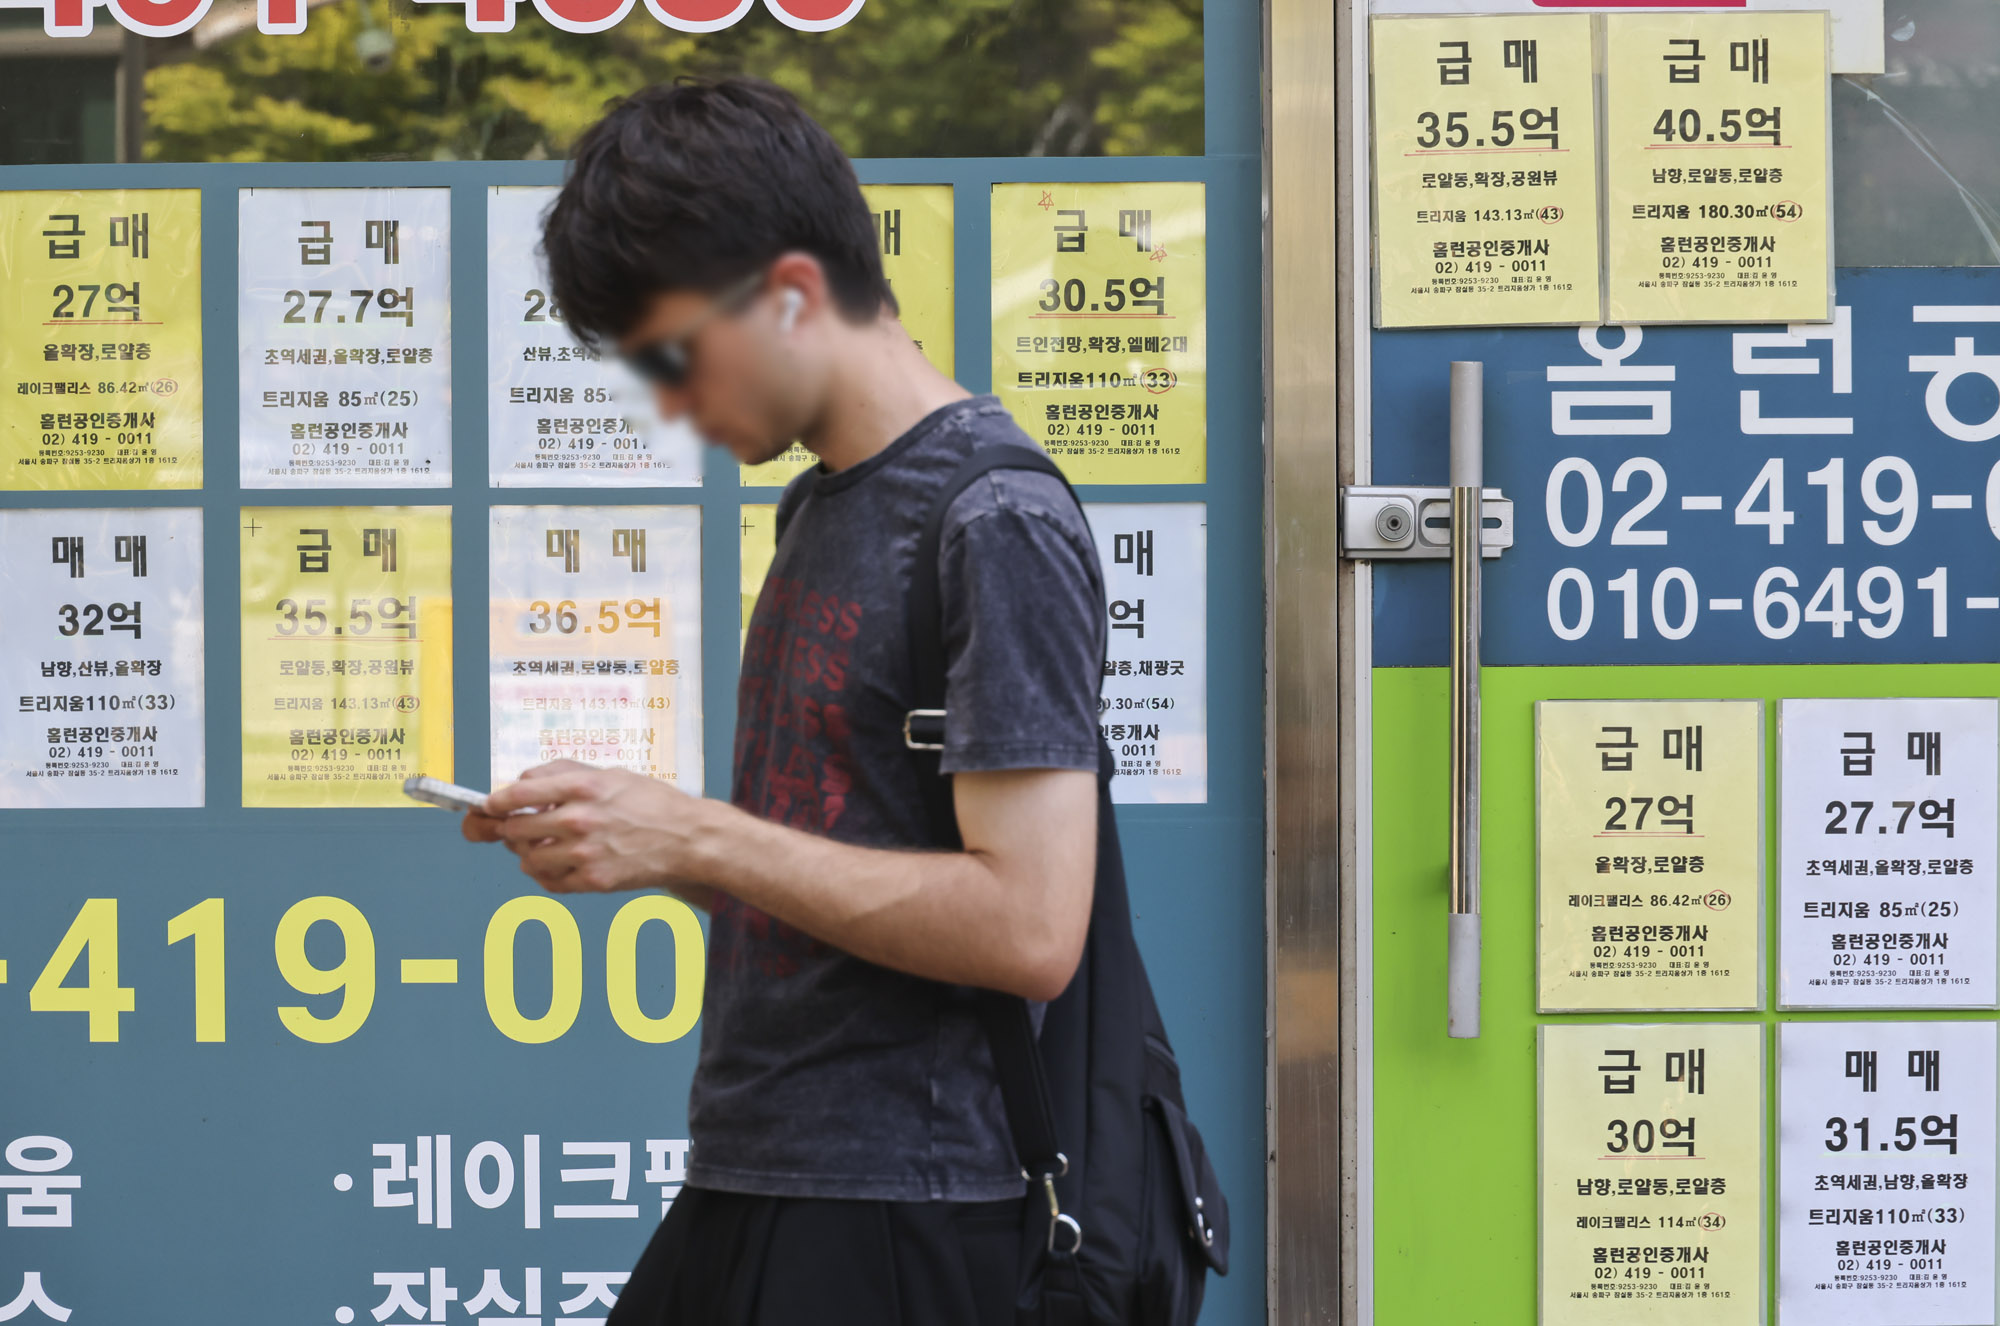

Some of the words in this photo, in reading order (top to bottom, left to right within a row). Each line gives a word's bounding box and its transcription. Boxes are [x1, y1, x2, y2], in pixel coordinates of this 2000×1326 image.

[1417, 107, 1559, 149] 35.5억
[1653, 107, 1781, 146] 40.5억
[1417, 210, 1466, 224] 트리지움
[1632, 205, 1690, 219] 트리지움
[1433, 239, 1550, 258] 홈런공인중개사
[1660, 236, 1776, 253] 홈런공인중개사
[1435, 260, 1458, 274] 02)
[1465, 260, 1492, 273] 419
[1512, 260, 1546, 273] 0011
[1662, 256, 1685, 269] 02)
[1692, 256, 1718, 268] 419
[1738, 256, 1772, 268] 0011
[51, 282, 142, 321] 27억
[1038, 277, 1166, 315] 30.5억
[284, 287, 413, 327] 27.7억
[262, 391, 329, 408] 트리지움
[509, 387, 574, 403] 트리지움
[584, 388, 613, 403] 85
[40, 412, 155, 430] 홈런공인중개사
[1046, 404, 1159, 421] 홈런공인중개사
[290, 422, 408, 439] 홈런공인중개사
[1047, 424, 1070, 436] 02)
[1077, 424, 1103, 435] 419
[1122, 424, 1155, 435] 0011
[1546, 456, 2000, 548] 02-419-
[58, 601, 141, 639] 32억
[276, 596, 416, 639] 35.5억
[529, 598, 661, 637] 36.5억
[274, 697, 323, 711] 트리지움
[47, 726, 157, 743] 홈런공인중개사
[289, 728, 405, 745] 홈런공인중개사
[49, 746, 71, 759] 02)
[78, 746, 103, 758] 419
[122, 746, 154, 758] 0011
[1122, 744, 1156, 757] 0011
[1605, 795, 1694, 834] 27억
[1825, 798, 1955, 838] 27.7억
[1803, 901, 1870, 918] 트리지움
[1591, 925, 1708, 942] 홈런공인중개사
[1831, 933, 1949, 950] 홈런공인중개사
[1593, 945, 1616, 958] 02)
[1624, 945, 1650, 957] 419
[1670, 945, 1704, 957] 0011
[0, 895, 705, 1044] 419-00
[1606, 1117, 1696, 1157] 30억
[1825, 1114, 1958, 1155] 31.5억
[1593, 1247, 1709, 1264] 홈런공인중개사
[1836, 1239, 1946, 1256] 홈런공인중개사
[1595, 1267, 1618, 1280] 02)
[1624, 1267, 1651, 1279] 419
[1671, 1267, 1705, 1279] 0011
